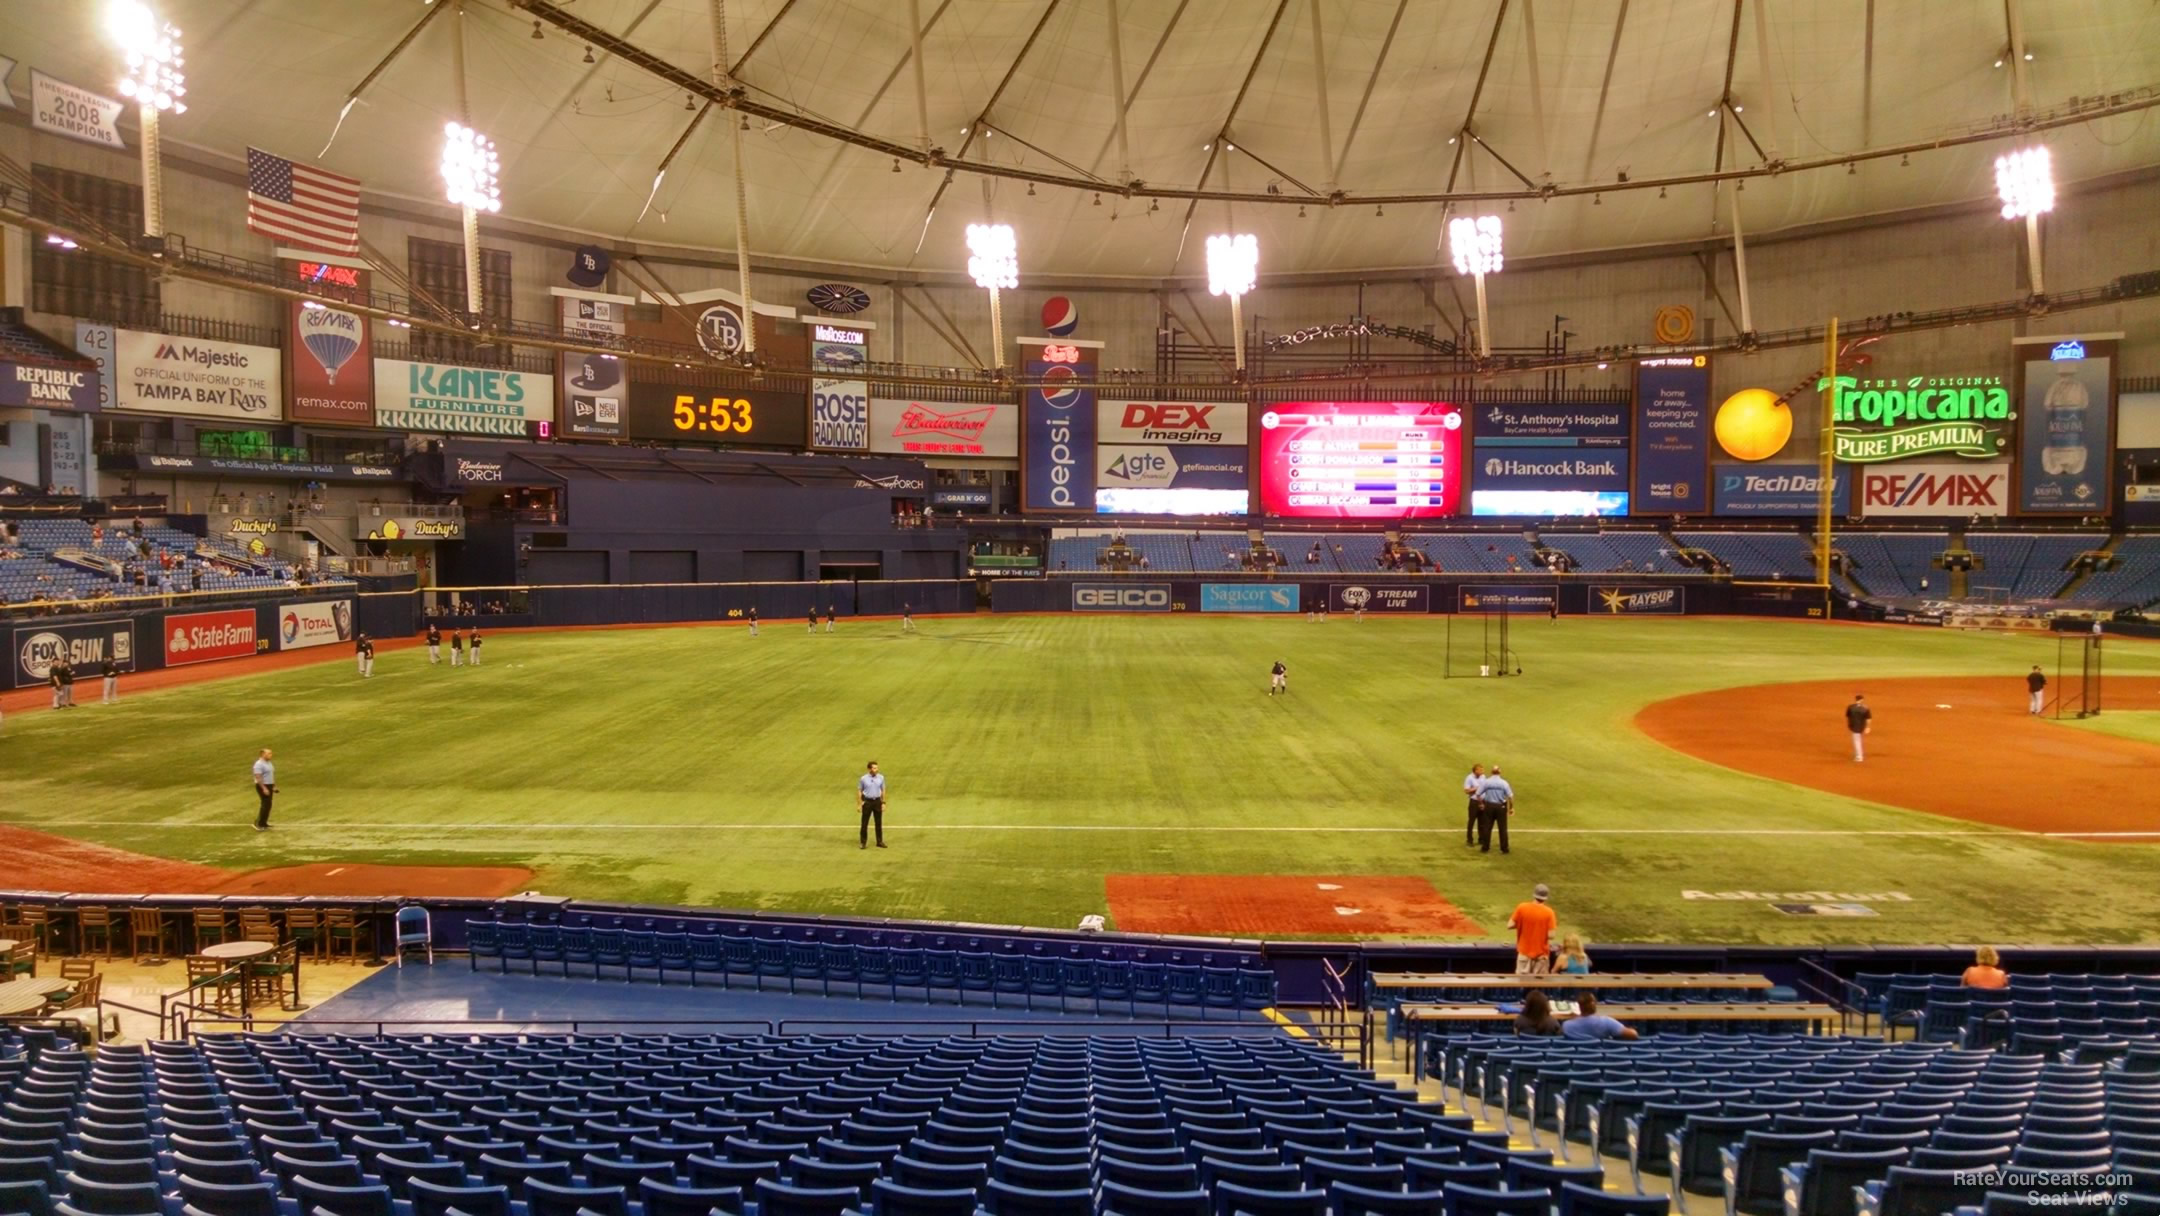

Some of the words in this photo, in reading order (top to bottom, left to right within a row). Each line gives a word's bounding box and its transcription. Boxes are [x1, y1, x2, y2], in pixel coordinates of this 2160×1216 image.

[40, 81, 80, 100] AMERICAN
[82, 95, 111, 110] LEAGUE
[54, 96, 100, 126] 2008
[39, 111, 112, 142] CHAMPIONS
[583, 254, 596, 271] TB
[307, 311, 356, 333] RE/MAX
[84, 329, 108, 350] 42
[706, 316, 738, 350] TB
[183, 346, 249, 368] Majestic
[16, 366, 85, 388] REPUBLIC
[134, 367, 181, 382] OFFICIAL
[184, 371, 230, 387] UNIFORM
[232, 377, 246, 387] OF
[248, 378, 266, 390] THE
[584, 364, 595, 381] TB
[409, 364, 525, 403] KANE'S
[1863, 379, 1898, 388] THE
[1929, 376, 2001, 386] ORIGINAL
[31, 383, 72, 401] BANK
[134, 383, 192, 402] TAMPA
[196, 389, 227, 404] BAY
[229, 388, 268, 412] RAYS
[1660, 388, 1686, 398] home
[297, 396, 368, 411] remax.com
[415, 399, 518, 415] FURNITURE
[599, 403, 616, 411] NEW
[814, 393, 866, 423] ROSE
[1817, 376, 2009, 427] Tropicana
[673, 395, 753, 433] 5:53
[902, 412, 986, 430] Budweiser
[1120, 404, 1216, 429] DEX
[1504, 415, 1518, 425] St.
[1521, 414, 1573, 427] Anthony's
[1575, 414, 1619, 427] Hospital
[1646, 409, 1680, 419] keeping
[1682, 410, 1699, 419] you
[539, 421, 549, 437] 0
[1649, 420, 1696, 428] connected.
[814, 422, 866, 447] RADIOLOGY
[1142, 429, 1223, 442] imaging
[1836, 437, 1887, 456] PURE
[1891, 428, 1984, 453] PREMIUM
[227, 460, 254, 469] Official
[254, 462, 270, 471] App
[278, 463, 312, 472] Tropicana
[313, 465, 334, 473] Field
[1047, 419, 1075, 506] pepsi
[1130, 453, 1166, 475] gte
[1182, 464, 1243, 473] gtefinancial.org
[1504, 460, 1573, 475] Hancock
[1575, 460, 1616, 475] Bank
[458, 470, 502, 481] PORCH
[893, 480, 923, 489] PORCH
[1745, 476, 1787, 492] Tech
[1789, 475, 1837, 492] Data
[1866, 473, 1998, 507] RE/MAX
[232, 518, 277, 536] Ducky's
[415, 520, 459, 538] Ducky's
[1076, 589, 1168, 606] GEICO
[1210, 585, 1266, 605] Sagicor
[1348, 590, 1364, 598] FOX
[1376, 590, 1418, 598] STREAM
[1386, 599, 1407, 607] LIVE
[728, 609, 743, 617] 404
[301, 617, 333, 630] TOTAL
[31, 641, 58, 661] FOX
[70, 637, 104, 665] SUN
[257, 639, 269, 650] 370
[32, 660, 53, 669] SPOR
